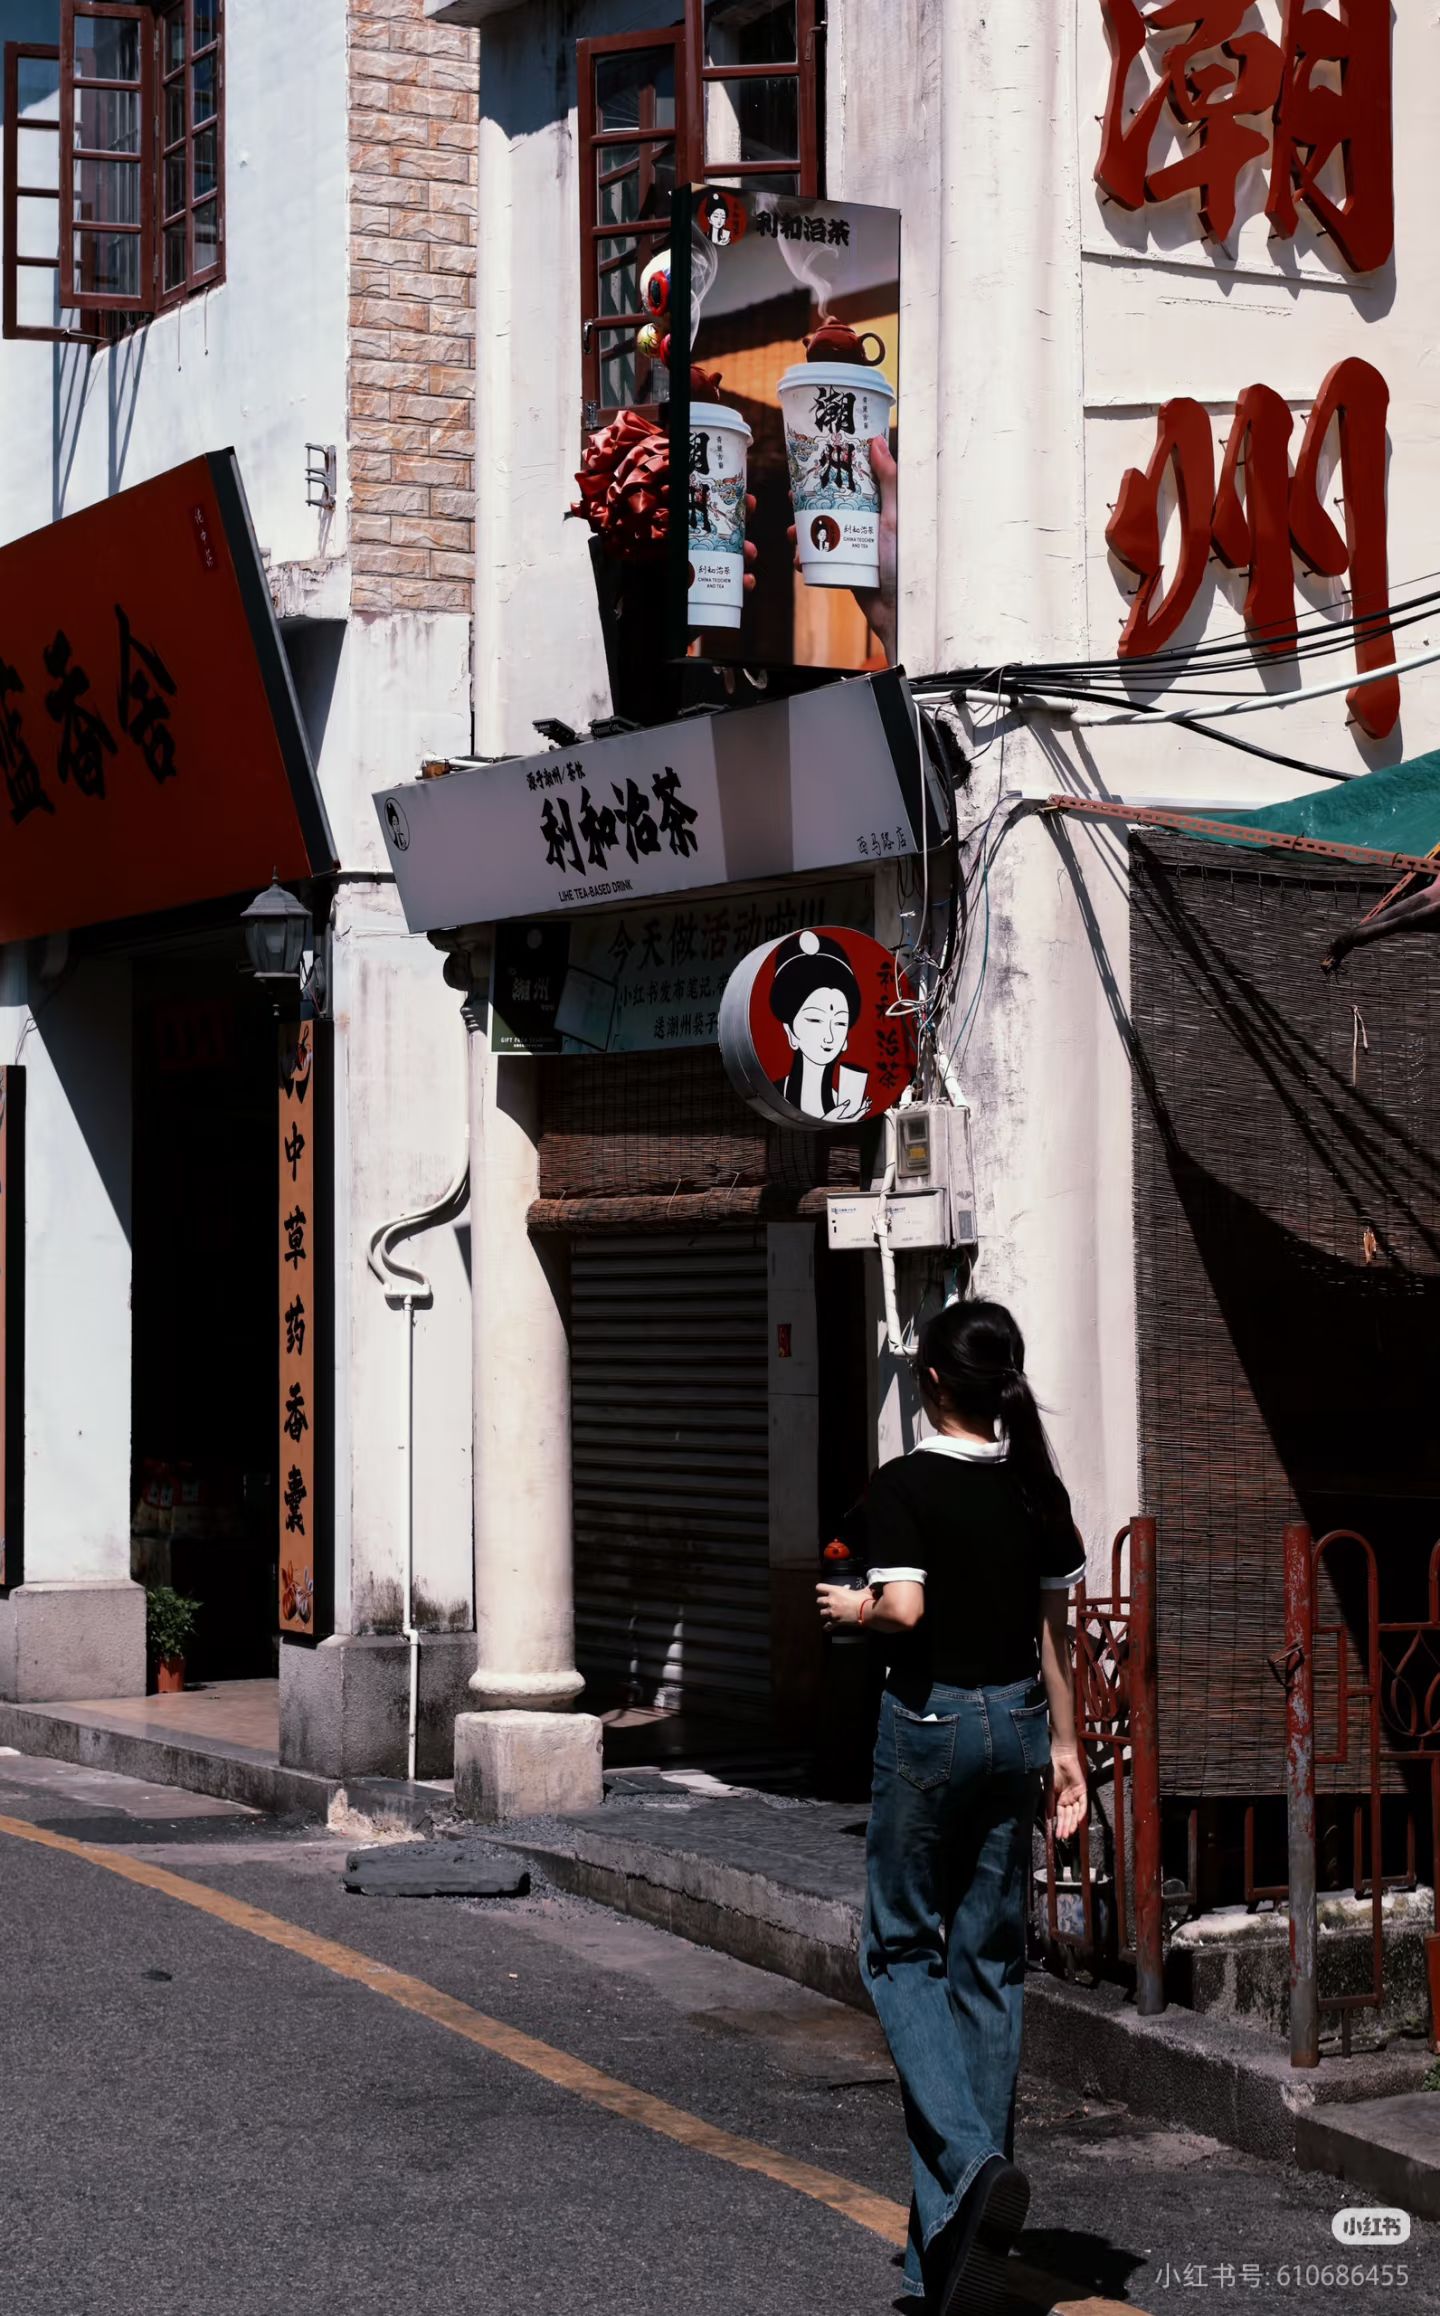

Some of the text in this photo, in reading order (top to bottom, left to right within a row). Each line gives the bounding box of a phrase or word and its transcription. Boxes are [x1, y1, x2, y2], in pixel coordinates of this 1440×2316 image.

[558, 879, 633, 902] LIHE TEA-BASED DRINK
[284, 1121, 308, 1536] 中草药香囊
